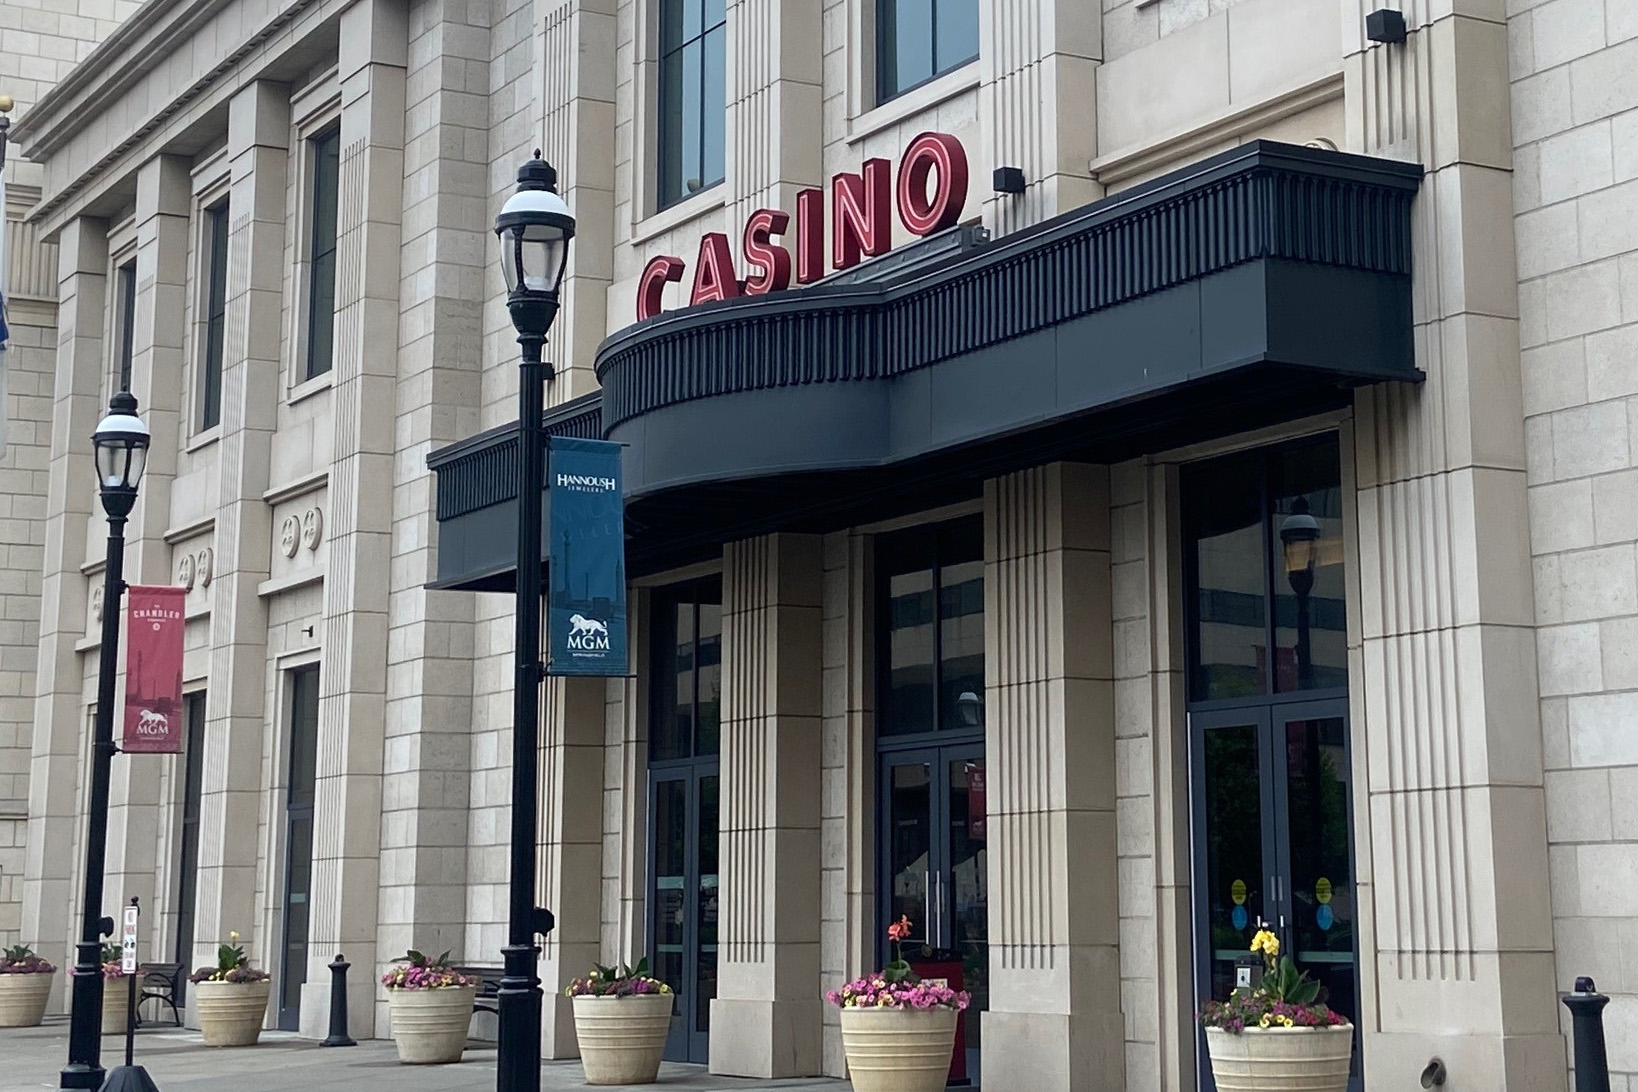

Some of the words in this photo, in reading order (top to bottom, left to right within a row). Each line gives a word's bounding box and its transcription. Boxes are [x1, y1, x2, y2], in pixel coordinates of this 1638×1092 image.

[636, 131, 969, 321] CASINO
[557, 473, 616, 491] HANNOUSH
[133, 609, 180, 619] CHANDLER
[567, 635, 611, 650] MGM
[136, 724, 169, 735] MGM
